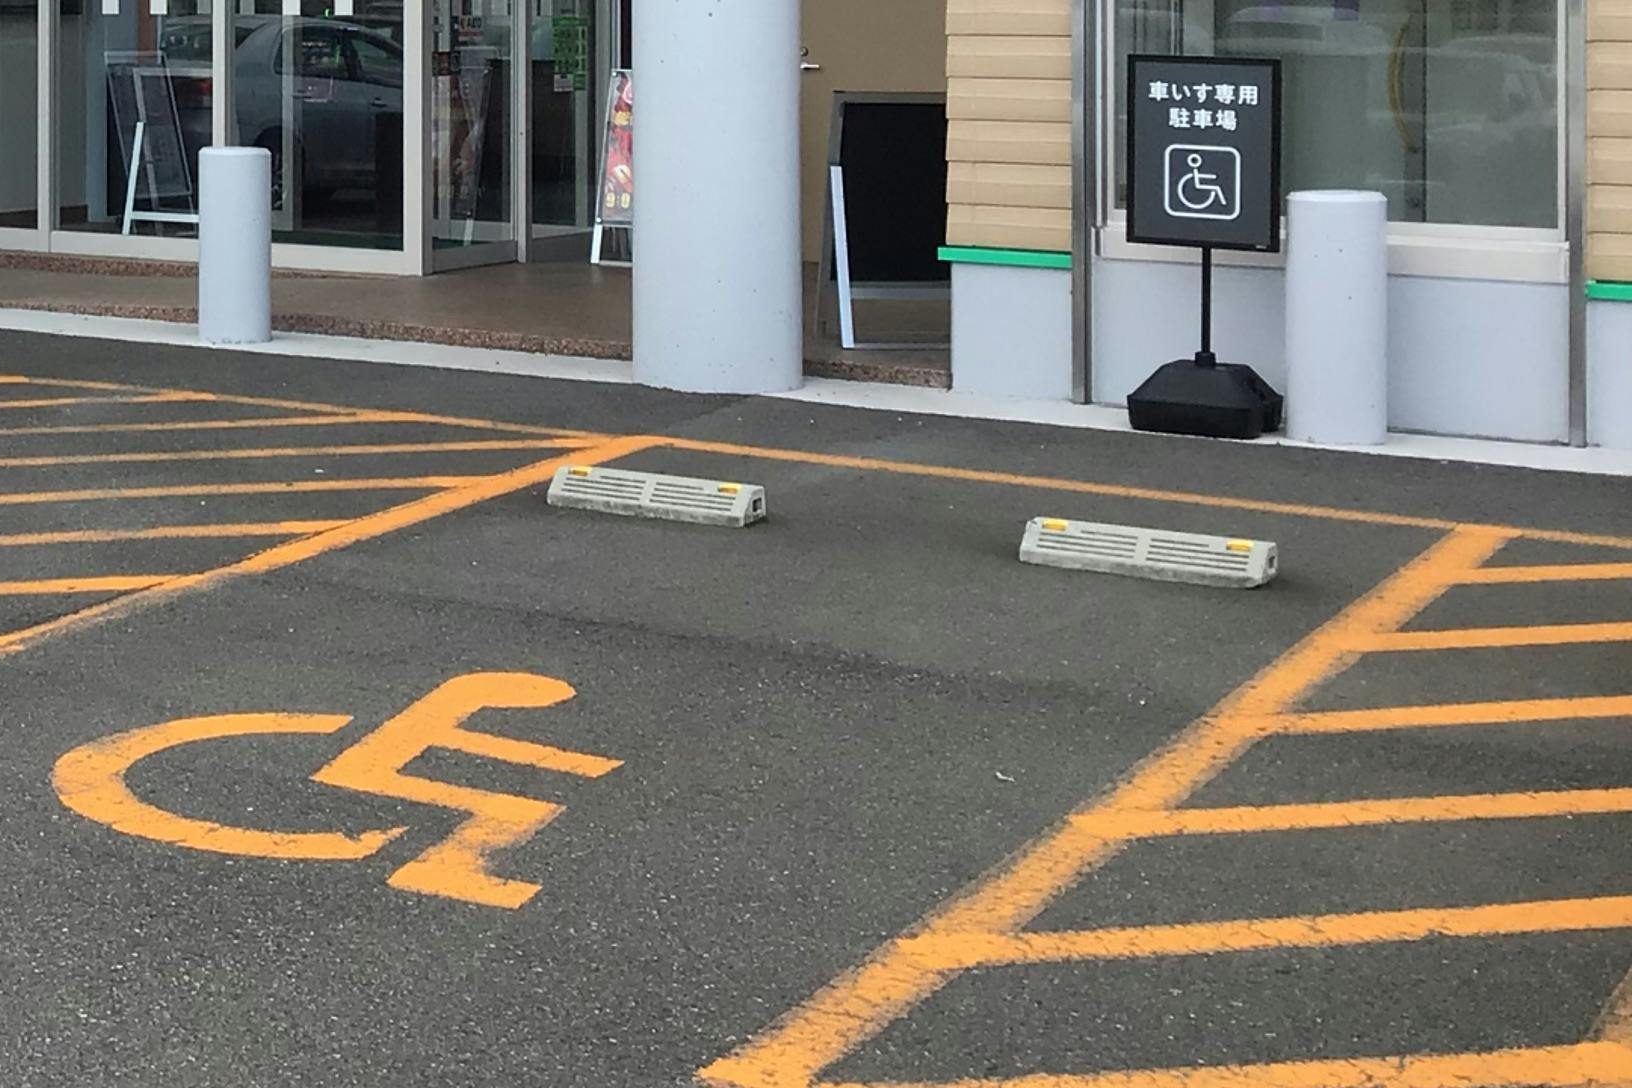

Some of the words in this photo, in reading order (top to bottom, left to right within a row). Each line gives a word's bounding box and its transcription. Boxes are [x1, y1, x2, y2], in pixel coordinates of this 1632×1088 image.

[1148, 80, 1258, 105] 車いす専用
[1169, 107, 1237, 131] 駐車場
